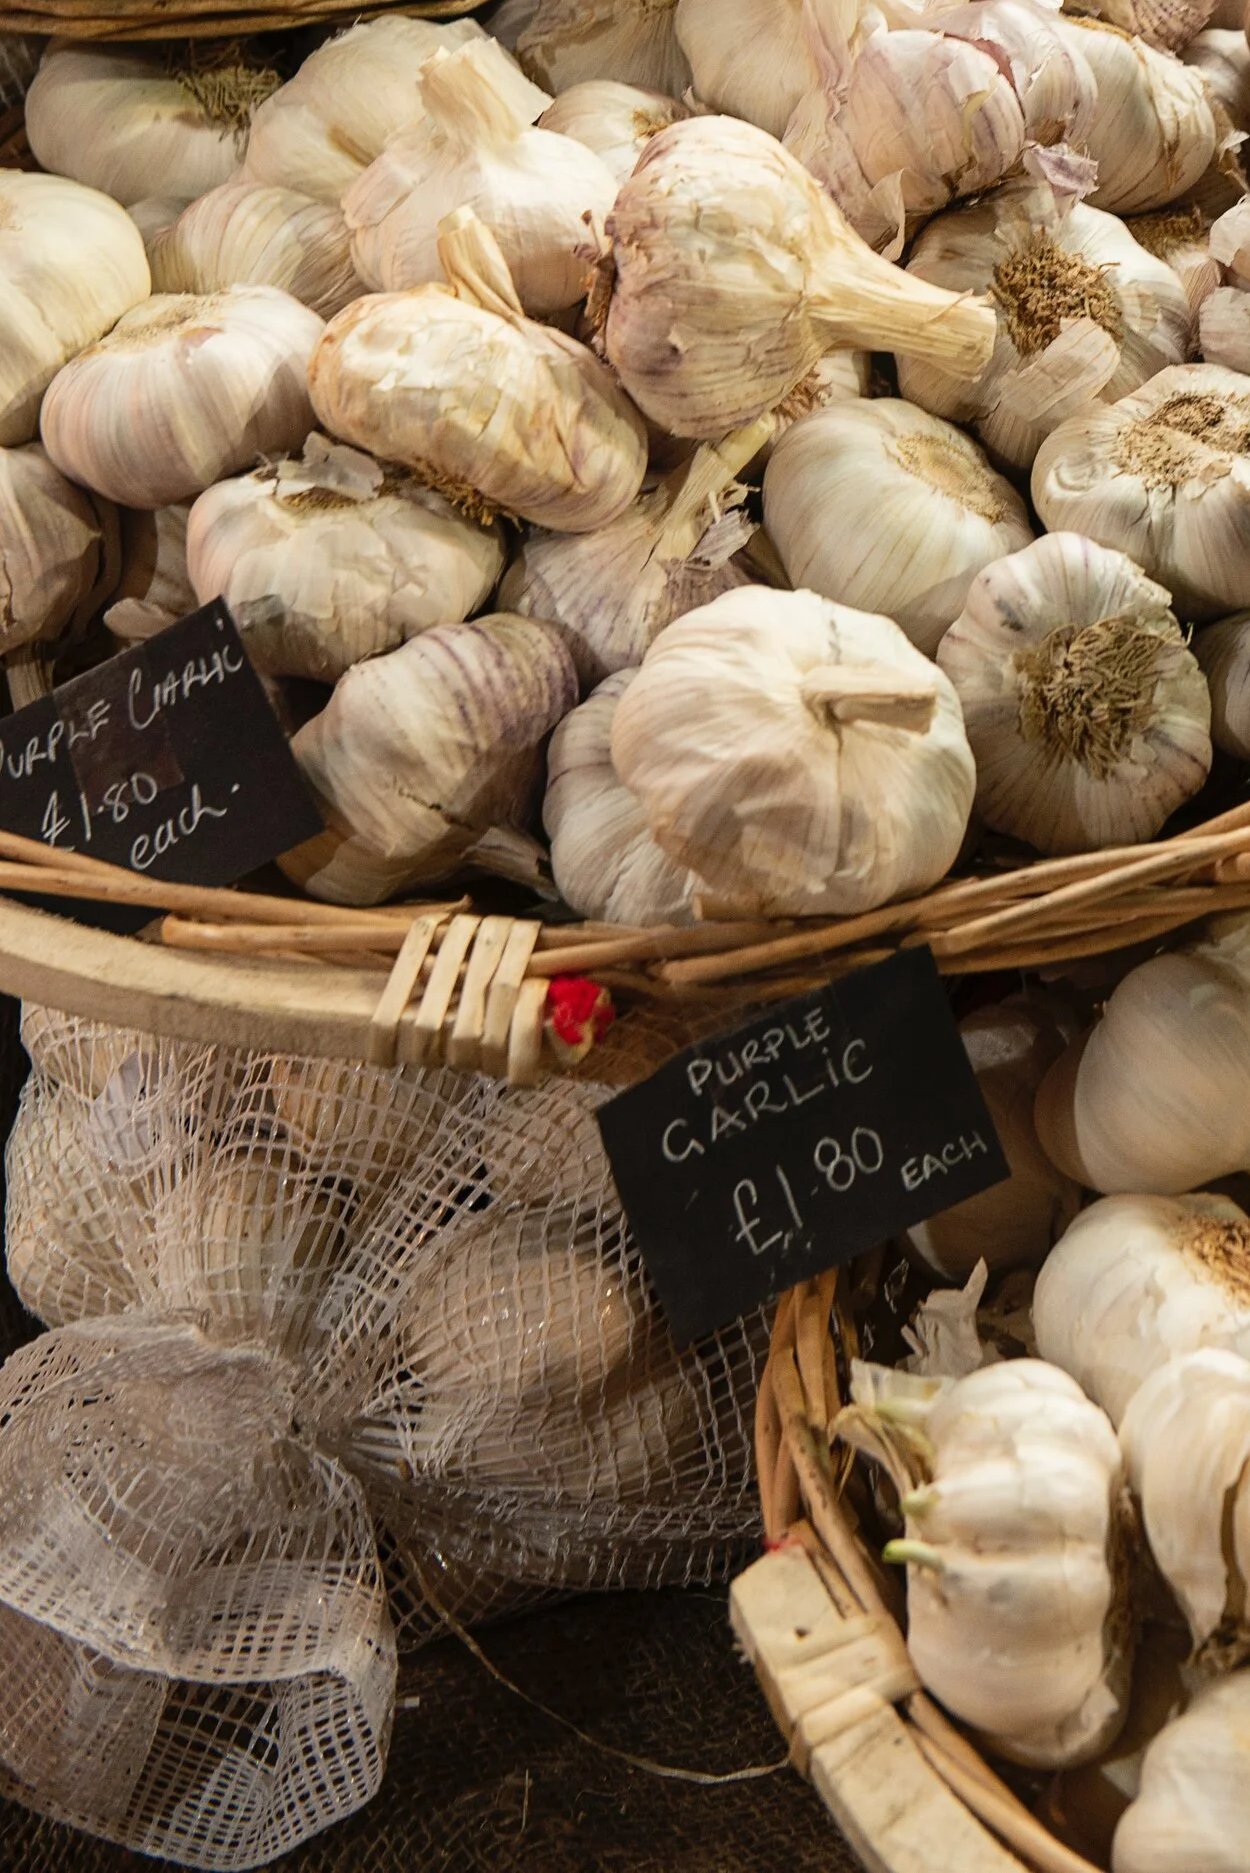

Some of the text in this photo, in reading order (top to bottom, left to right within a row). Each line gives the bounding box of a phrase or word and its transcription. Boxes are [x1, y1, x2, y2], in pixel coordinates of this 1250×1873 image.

[0, 698, 111, 779] URPLE
[41, 772, 158, 852] £1.80
[686, 1006, 831, 1096] PURPLE
[733, 1125, 988, 1256] £1.80 EACH
